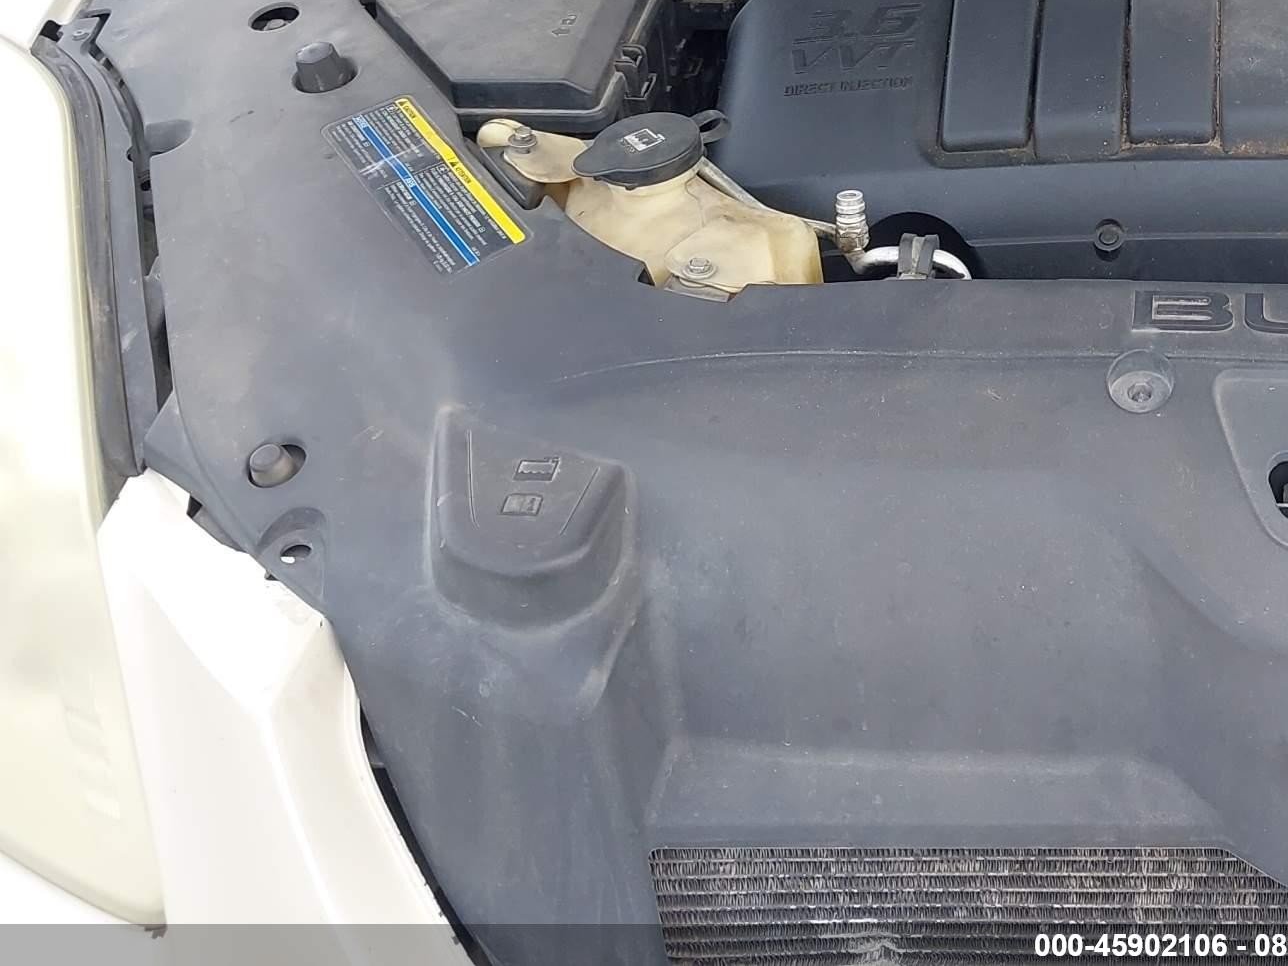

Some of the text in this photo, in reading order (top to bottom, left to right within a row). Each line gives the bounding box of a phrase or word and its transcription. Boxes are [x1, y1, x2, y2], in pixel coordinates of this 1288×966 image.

[791, 39, 915, 75] VVT
[783, 76, 914, 97] DIRECT INJECTION
